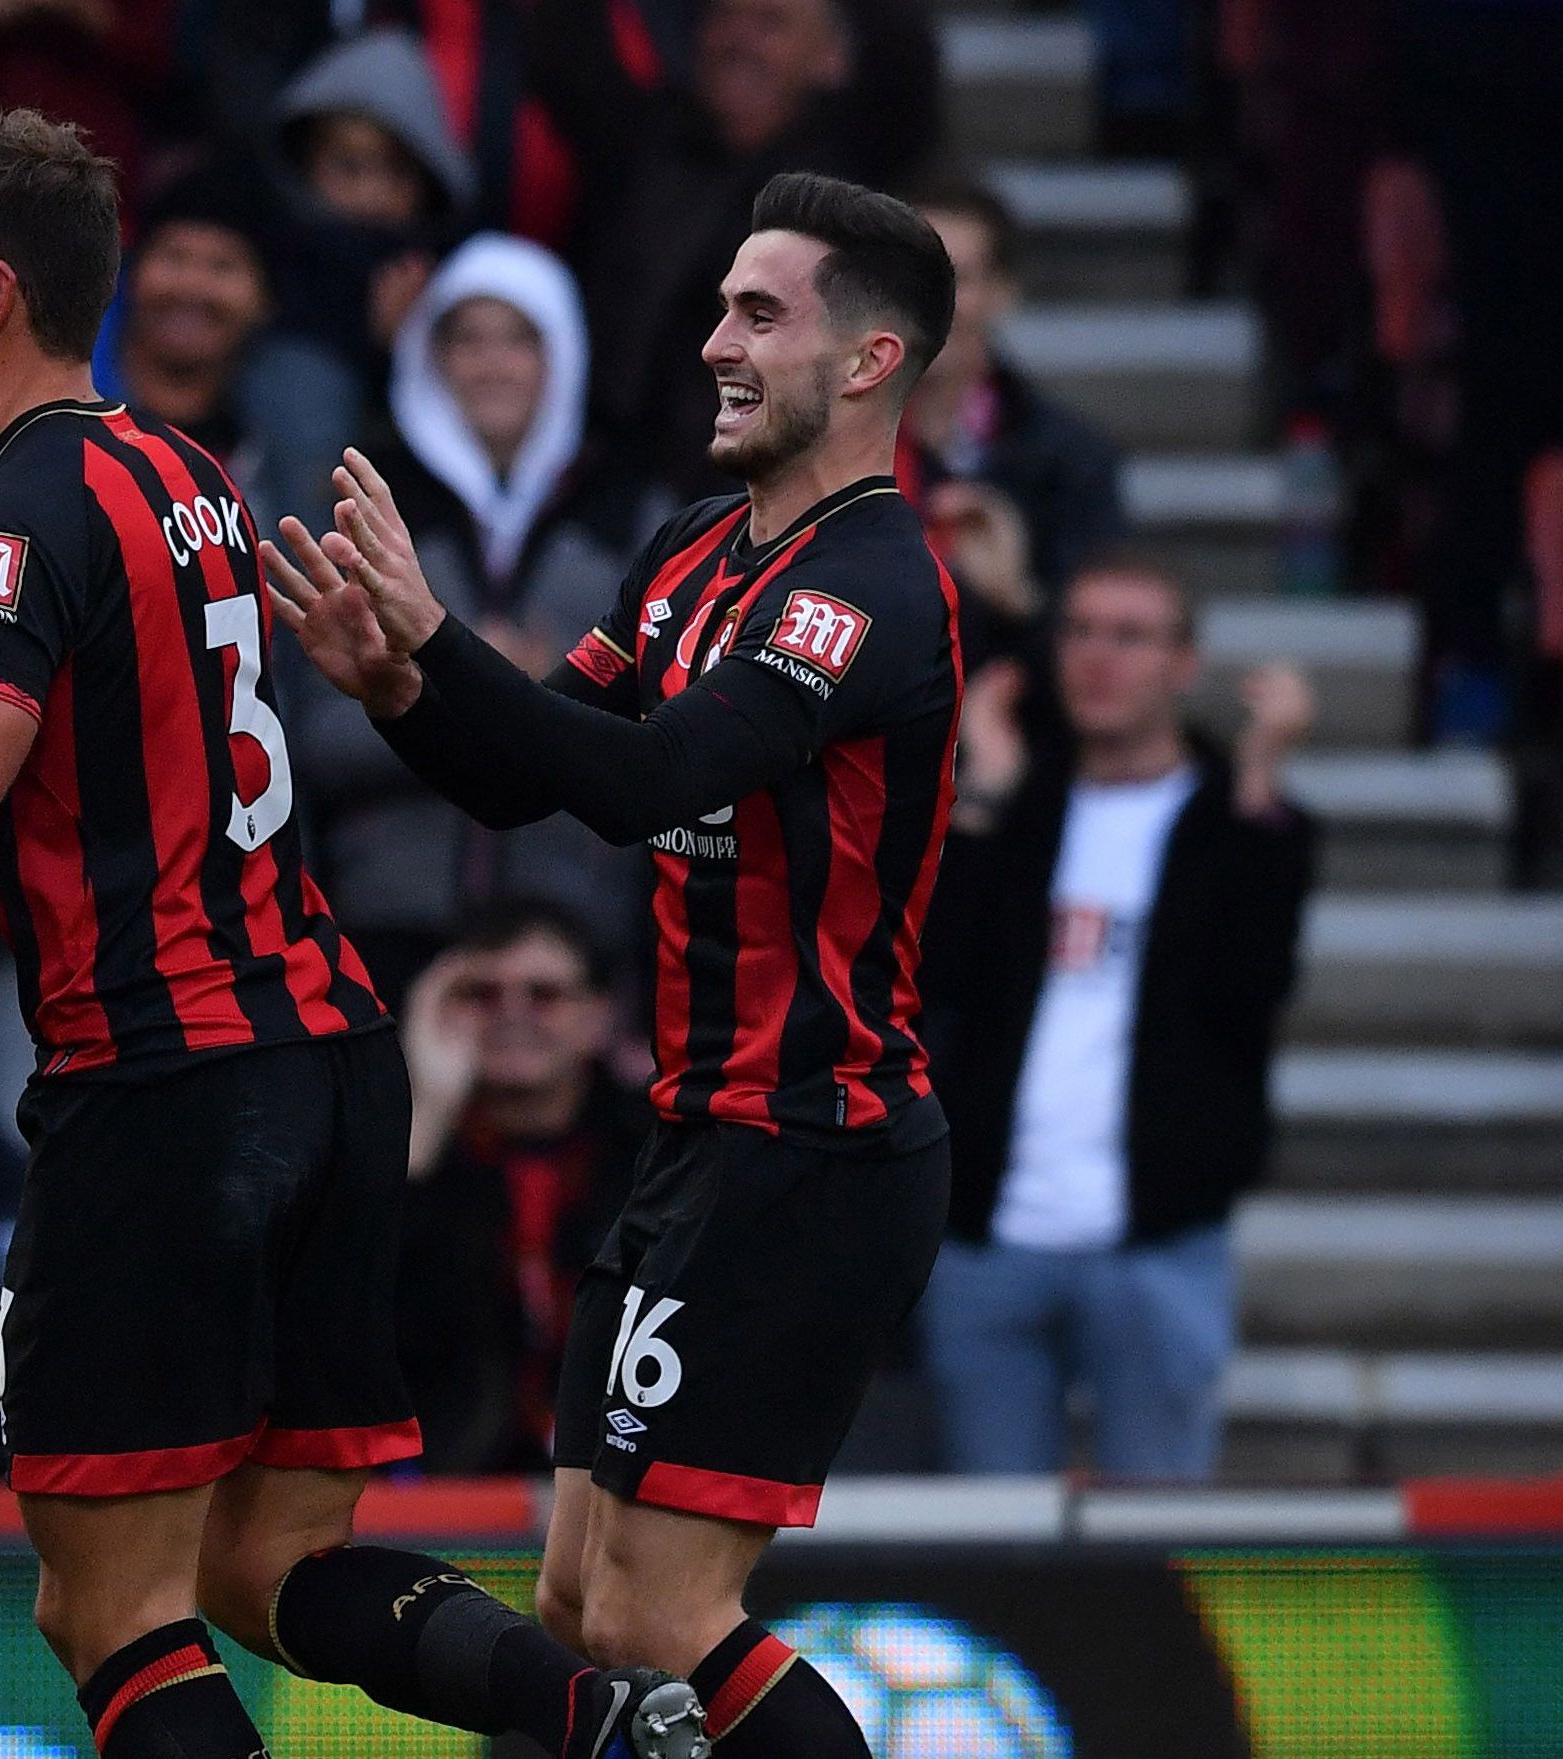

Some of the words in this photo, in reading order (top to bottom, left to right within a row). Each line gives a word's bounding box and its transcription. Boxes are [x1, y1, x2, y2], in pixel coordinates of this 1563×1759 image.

[163, 494, 248, 567] COOK
[203, 592, 293, 853] 3
[753, 648, 834, 701] MANSION
[605, 1285, 686, 1408] 16
